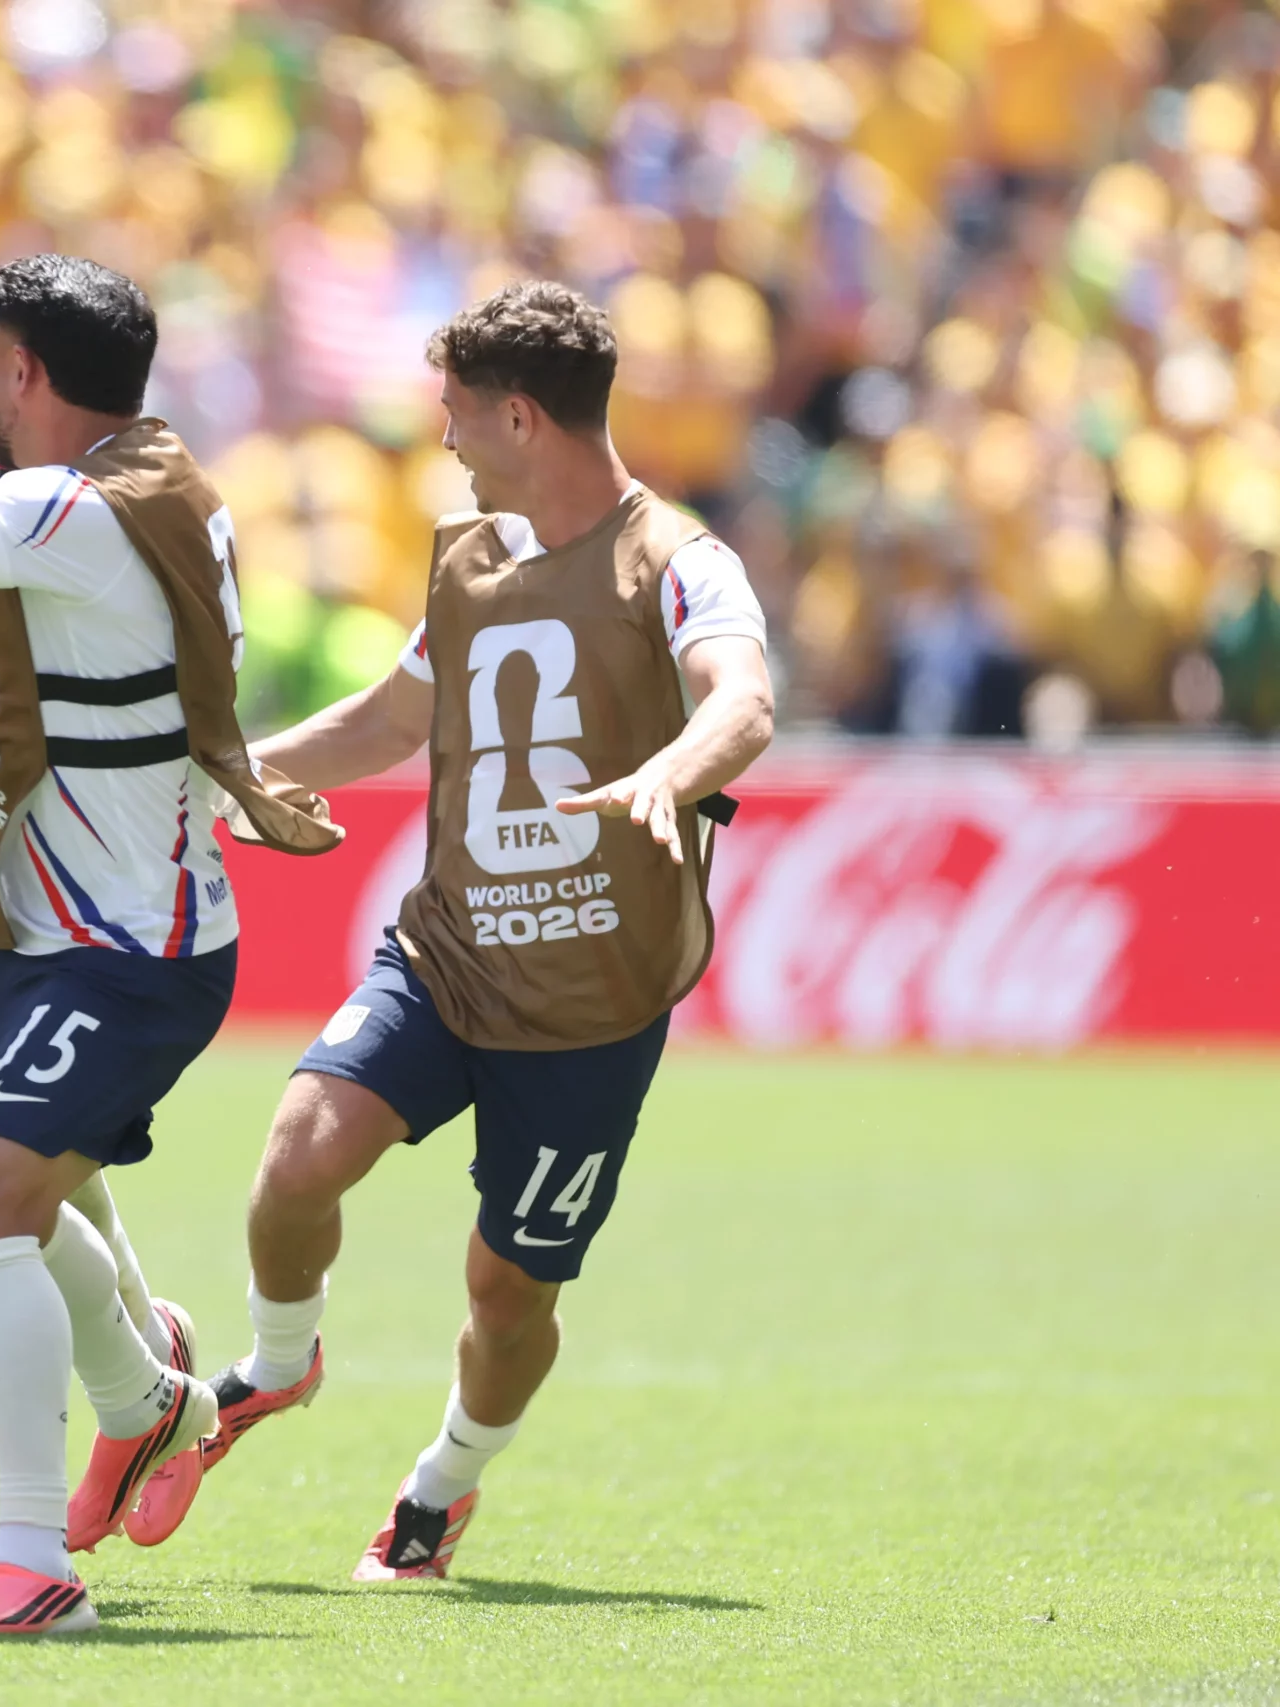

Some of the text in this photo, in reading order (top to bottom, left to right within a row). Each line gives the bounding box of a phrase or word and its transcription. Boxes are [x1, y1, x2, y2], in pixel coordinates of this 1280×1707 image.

[497, 821, 561, 850] FIFA
[465, 872, 612, 908] WORLD CUP
[470, 898, 620, 946] 2026
[512, 1145, 608, 1228] 14
